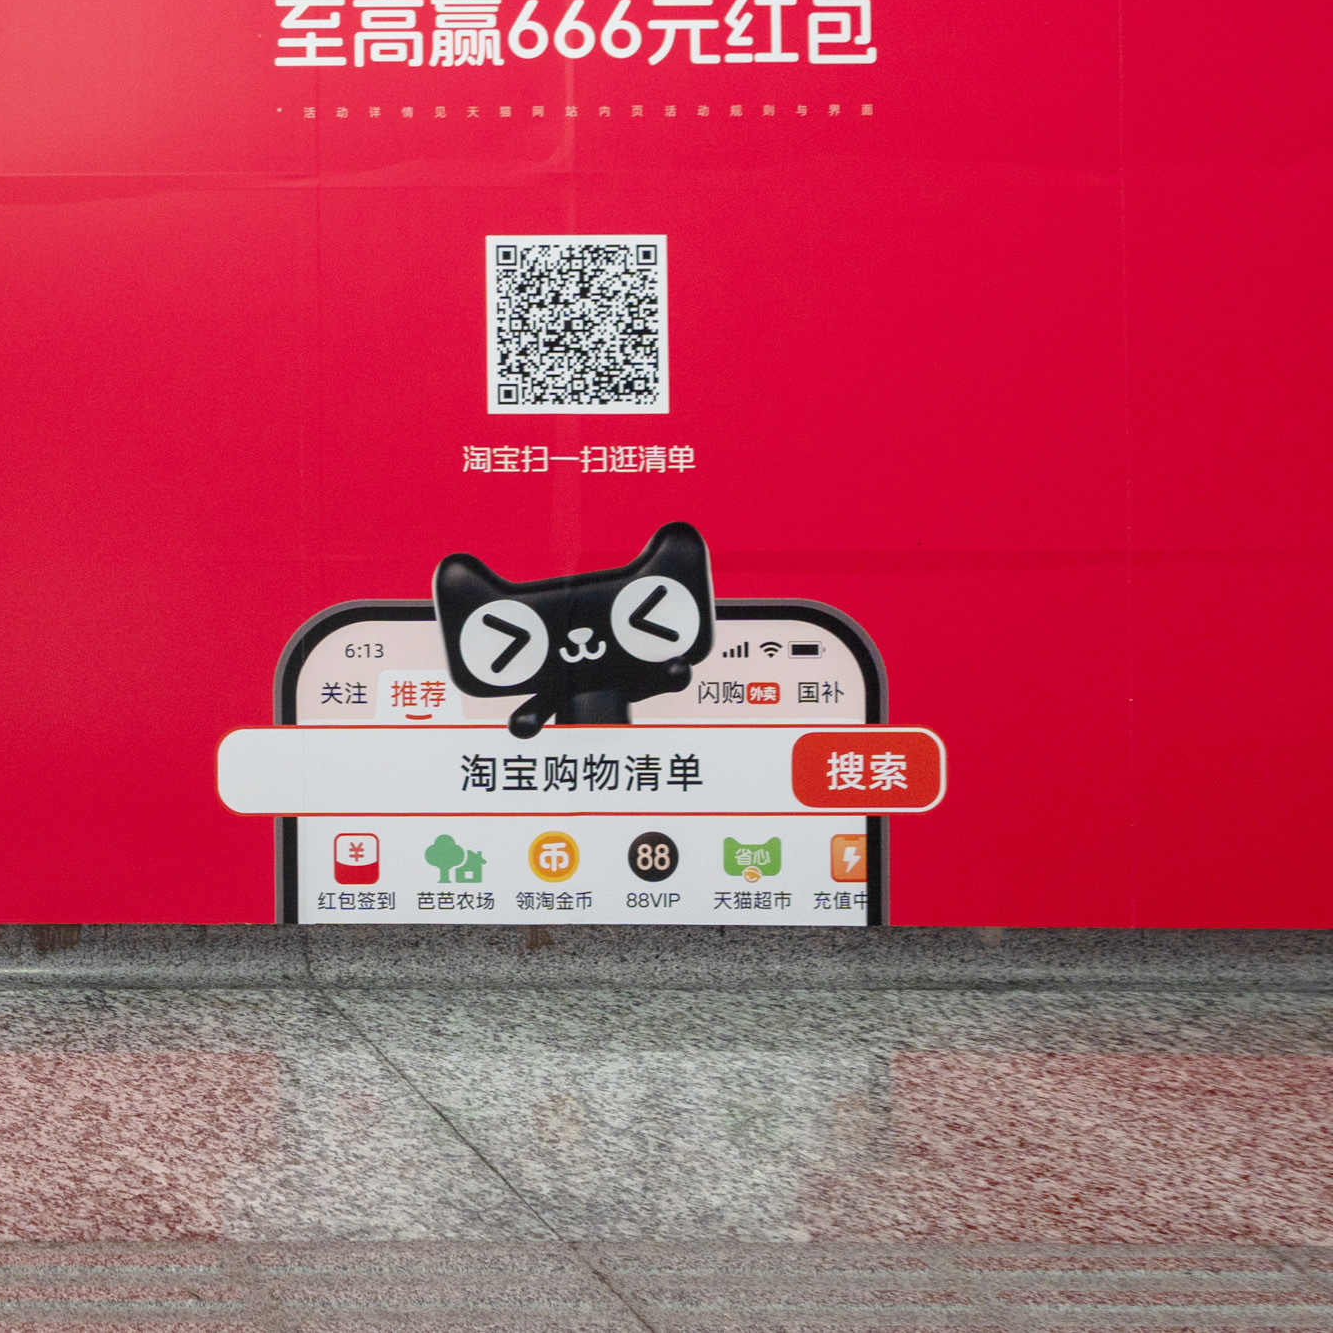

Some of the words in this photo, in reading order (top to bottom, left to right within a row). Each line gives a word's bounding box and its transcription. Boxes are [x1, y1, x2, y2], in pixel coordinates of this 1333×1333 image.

[463, 445, 695, 473] 淘宝扫一扫逛清单
[345, 644, 383, 658] 6:13
[321, 682, 367, 704] 关注
[392, 682, 445, 707] 推荐
[699, 681, 744, 704] 闪购
[750, 686, 778, 702] 外卖
[798, 681, 844, 703] 国补
[461, 754, 702, 792] 淘宝购物清单
[827, 752, 907, 790] 搜索
[539, 842, 569, 871] 币
[637, 844, 670, 870] 88
[318, 892, 395, 910] 红包签到
[417, 892, 494, 910] 芭芭农场
[516, 891, 592, 910] 领淘金币
[627, 893, 680, 908] 88VIP
[714, 891, 792, 909] 天猫超市
